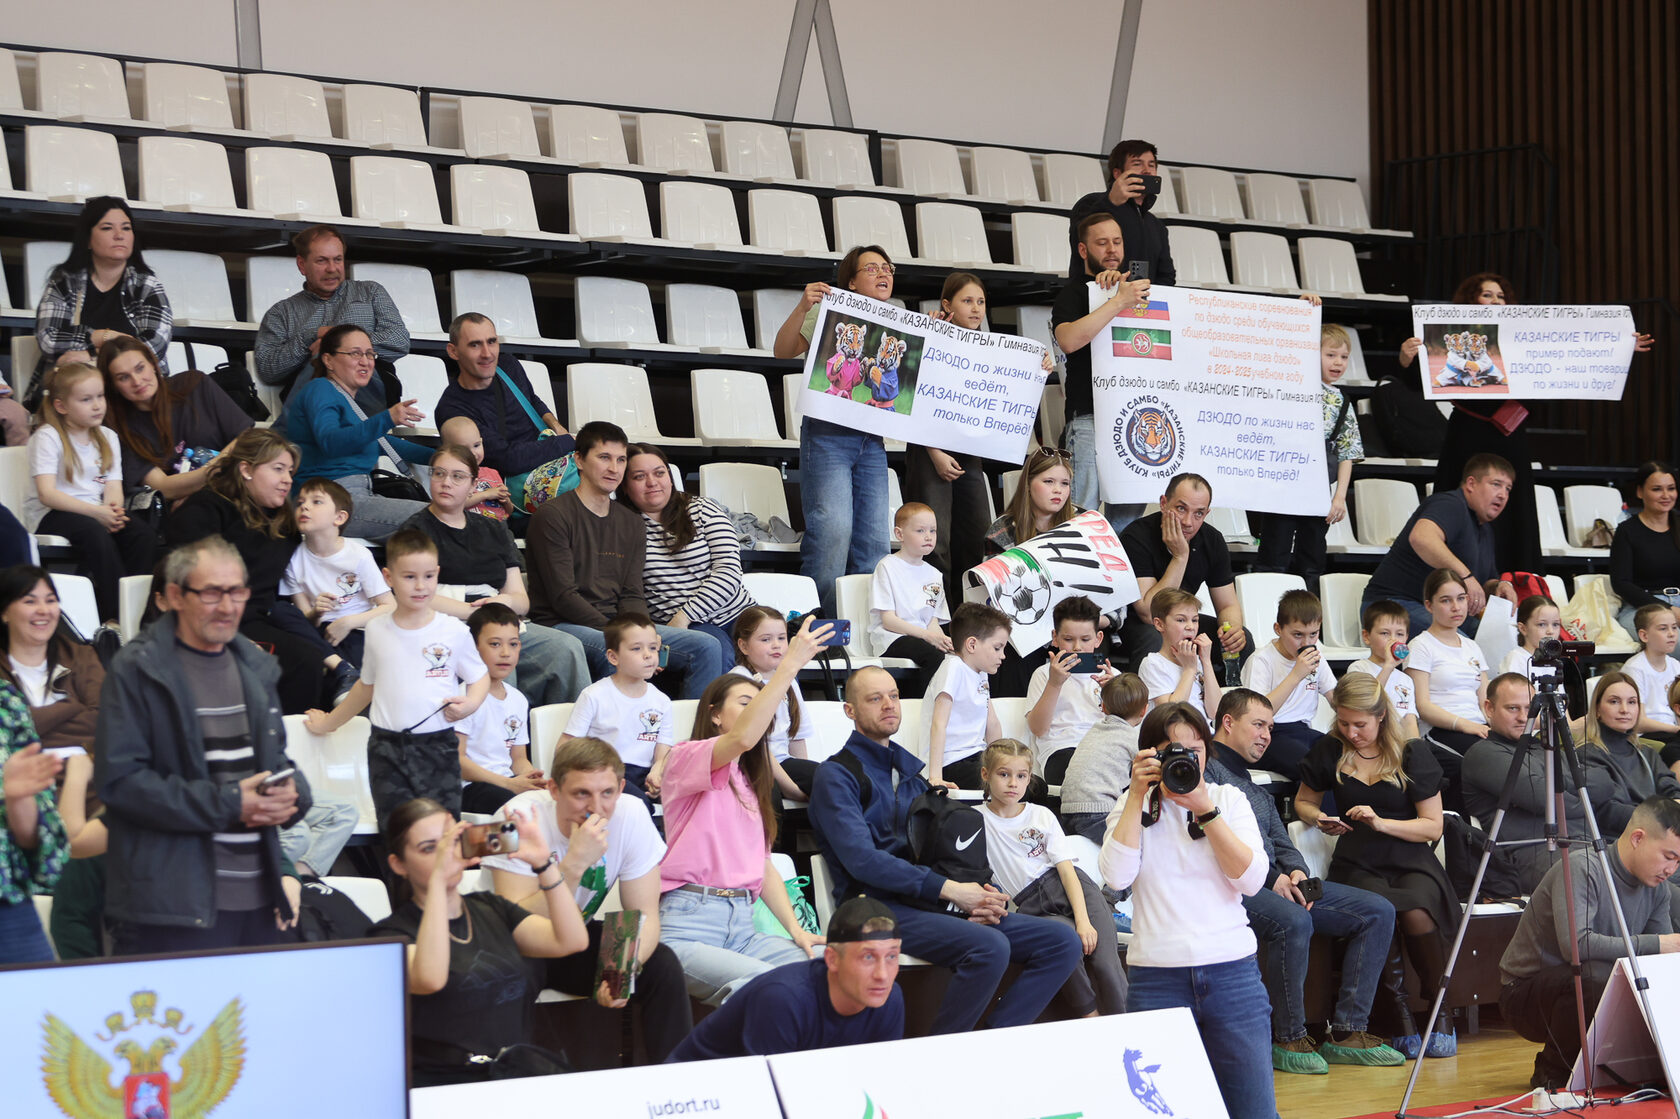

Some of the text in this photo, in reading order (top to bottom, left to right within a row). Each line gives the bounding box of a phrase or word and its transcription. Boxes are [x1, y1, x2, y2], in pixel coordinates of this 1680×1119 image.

[1194, 312, 1204, 322] по
[1206, 312, 1231, 324] дзюдо
[1414, 306, 1435, 320] Клуб
[1437, 307, 1460, 318] дзюдо
[1462, 310, 1468, 318] и
[1469, 307, 1493, 318] самбо
[1586, 308, 1620, 318] Гимназия
[846, 295, 872, 312] дзюдо
[872, 306, 878, 314] и
[878, 307, 898, 322] самбо
[900, 312, 955, 339] «КАЗАНСКИЕ
[956, 328, 995, 347] ТИГРЫ»
[998, 336, 1040, 354] Гимназия
[1514, 331, 1621, 342] КАЗАНСКИЕ ТИГРЫ
[923, 346, 970, 370] ДЗЮДО
[973, 363, 989, 374] по
[992, 366, 1032, 380] жизни
[1526, 348, 1614, 360] пример подают!
[1510, 362, 1552, 374] ДЗЮДО
[1564, 365, 1586, 374] наш
[964, 378, 1009, 396] ведёт,
[1093, 376, 1117, 390] Клуб
[1120, 376, 1147, 388] дзюдо
[1150, 380, 1154, 388] и
[1156, 380, 1180, 391] самбо
[1184, 382, 1240, 396] «КАЗАНСКИЕ
[1276, 389, 1314, 402] Гимназия
[1533, 378, 1616, 392] по жизни и друг!
[917, 383, 998, 411] КАЗАНСКИЕ
[1126, 395, 1159, 410] САМБО
[933, 408, 1031, 436] только Вперёд!
[1120, 408, 1128, 418] И
[1197, 410, 1315, 430] ДЗЮДО по жизни нас
[1112, 418, 1128, 458] ДЗЮДО
[1236, 432, 1276, 446] ведёт,
[1200, 444, 1266, 462] КАЗАНСКИЕ
[1269, 450, 1310, 464] ТИГРЫ
[1124, 458, 1148, 477] КЛУБ
[1216, 465, 1300, 482] только Вперёд!
[646, 1098, 720, 1119] judort.ru
